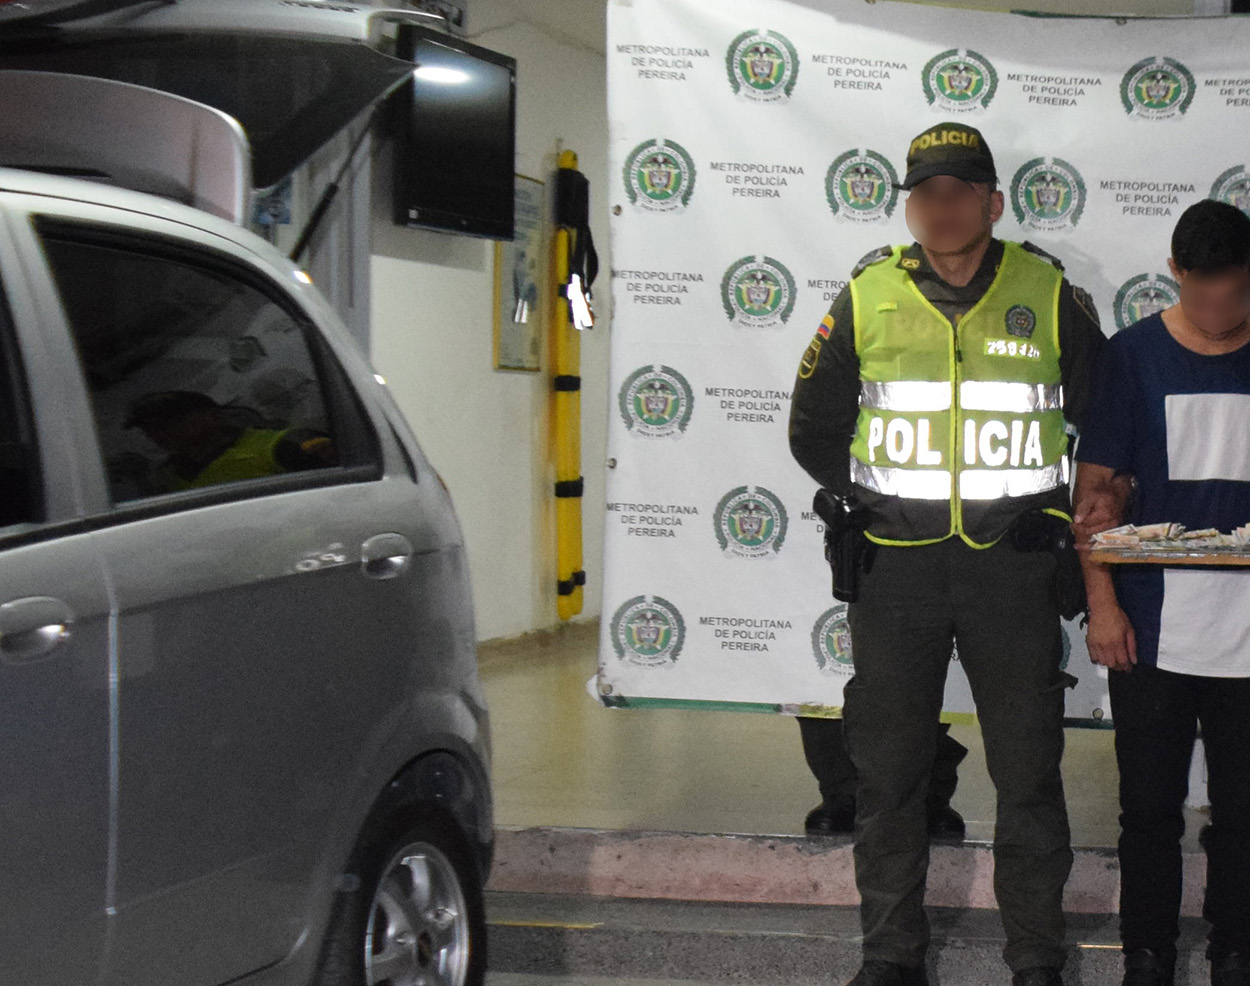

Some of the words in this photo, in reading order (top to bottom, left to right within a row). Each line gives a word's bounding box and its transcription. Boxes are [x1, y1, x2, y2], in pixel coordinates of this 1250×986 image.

[616, 44, 710, 58] METROPOLITANA
[631, 57, 647, 67] DE
[812, 54, 908, 70] METROPOLITANA
[638, 70, 686, 81] PEREIRA
[827, 68, 842, 76] DE
[1006, 74, 1102, 86] METROPOLITANA
[834, 80, 883, 91] PEREIRA
[1022, 84, 1037, 93] DE
[1220, 88, 1235, 96] DE
[1028, 96, 1077, 106] PEREIRA
[910, 130, 979, 156] POLICIA
[710, 162, 804, 175] METROPOLITANA
[726, 175, 741, 184] DE
[1100, 181, 1195, 194] METROPOLITANA
[732, 188, 780, 198] PEREIRA
[1116, 194, 1132, 203] DE
[1122, 206, 1171, 216] PEREIRA
[626, 282, 642, 292] DE
[633, 294, 681, 305] PEREIRA
[705, 388, 793, 400] METROPOLITAN
[720, 400, 735, 410] DE
[727, 412, 774, 423] PEREIRA
[607, 503, 699, 515] METROPOLITANA
[621, 515, 636, 524] DE
[628, 528, 675, 538] PEREIRA
[699, 616, 792, 629] METROPOLITANA
[714, 630, 729, 638] DE
[721, 642, 769, 652] PEREIRA
